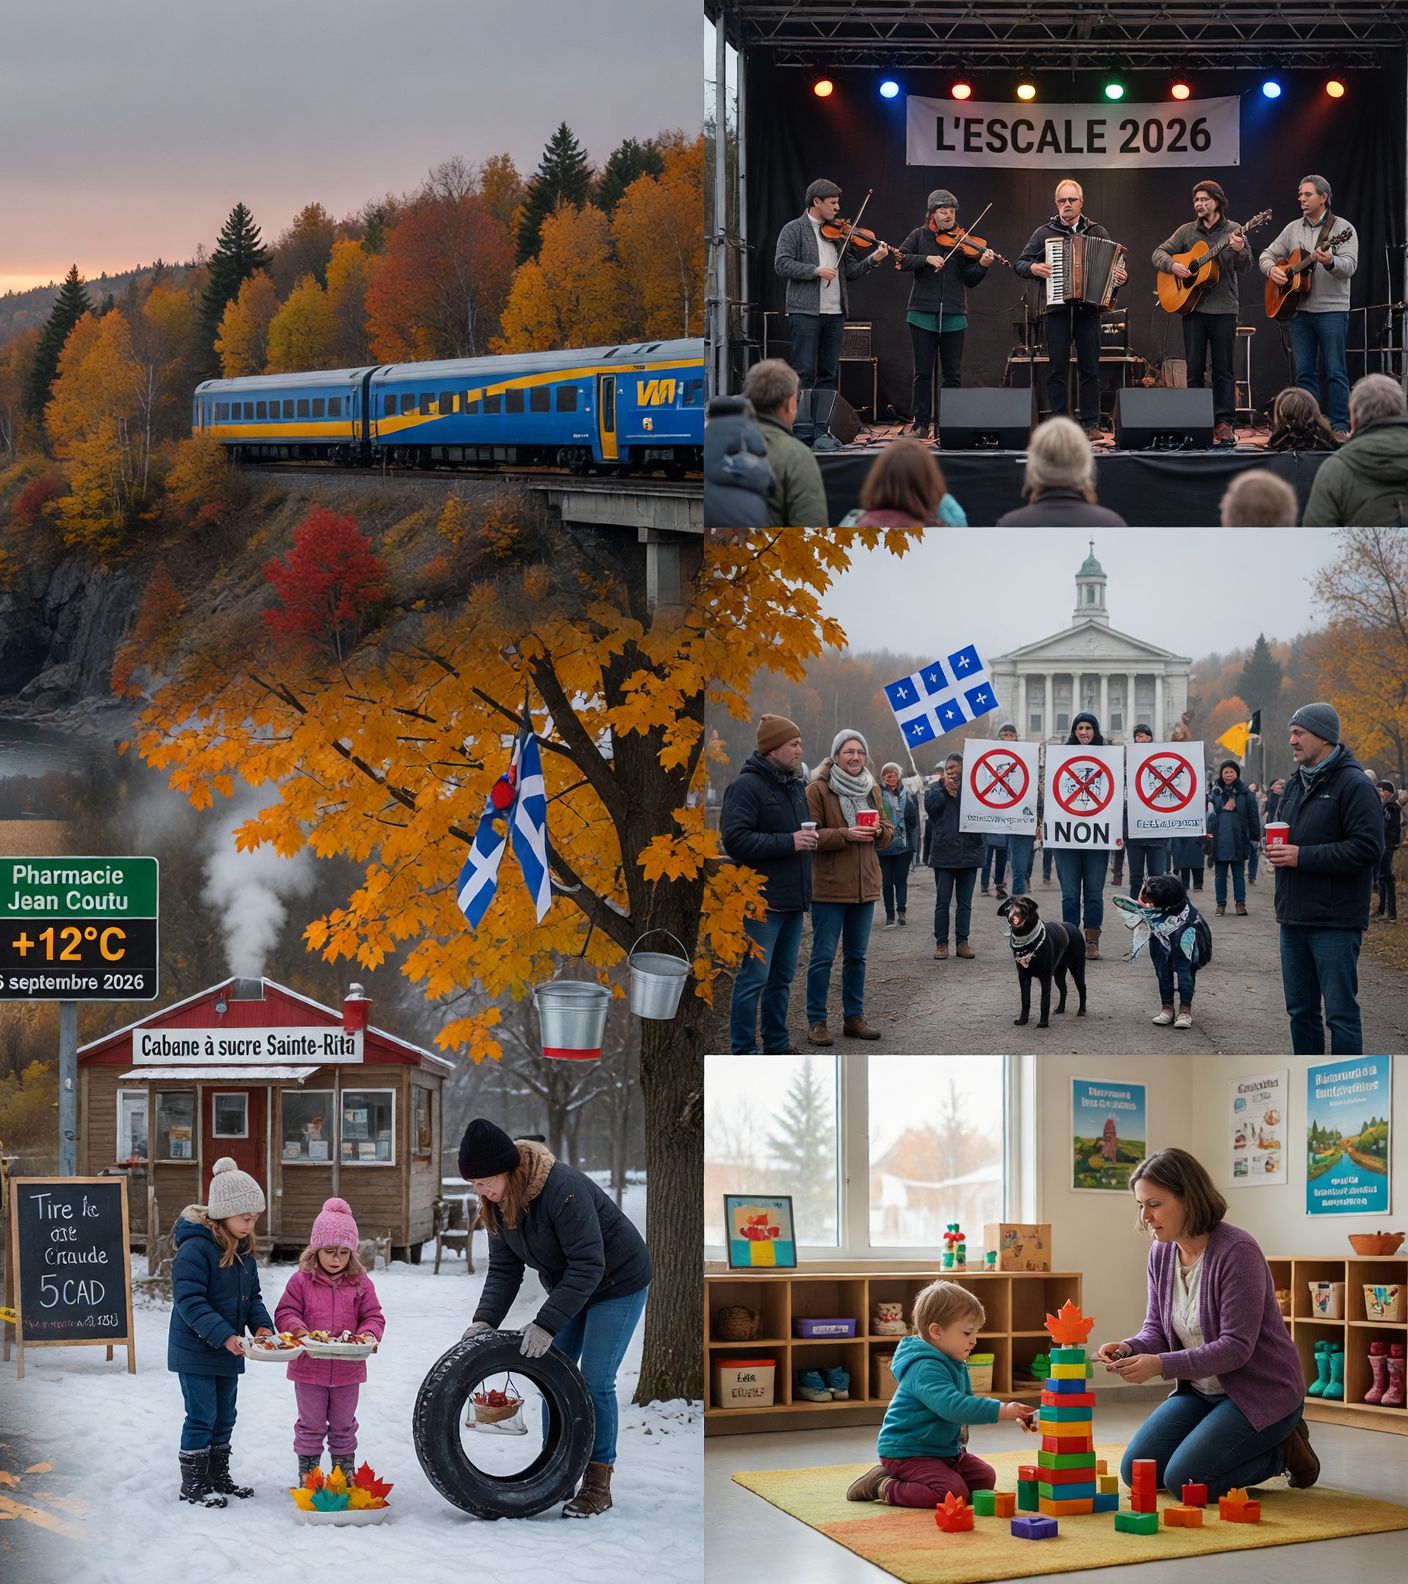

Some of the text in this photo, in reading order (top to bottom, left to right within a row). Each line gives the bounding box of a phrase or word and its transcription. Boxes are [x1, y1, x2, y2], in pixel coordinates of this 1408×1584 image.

[935, 116, 1212, 154] L'ESCALE 2026
[1054, 821, 1110, 845] NON
[12, 864, 124, 885] Pharmacie
[7, 891, 128, 911] Jean Coutu
[12, 926, 127, 962] +12°C
[8, 974, 98, 995] septembre
[103, 974, 145, 991] 2026
[141, 1033, 356, 1057] Cabane à sucre Sainte-Rita
[29, 1192, 74, 1220] Tire
